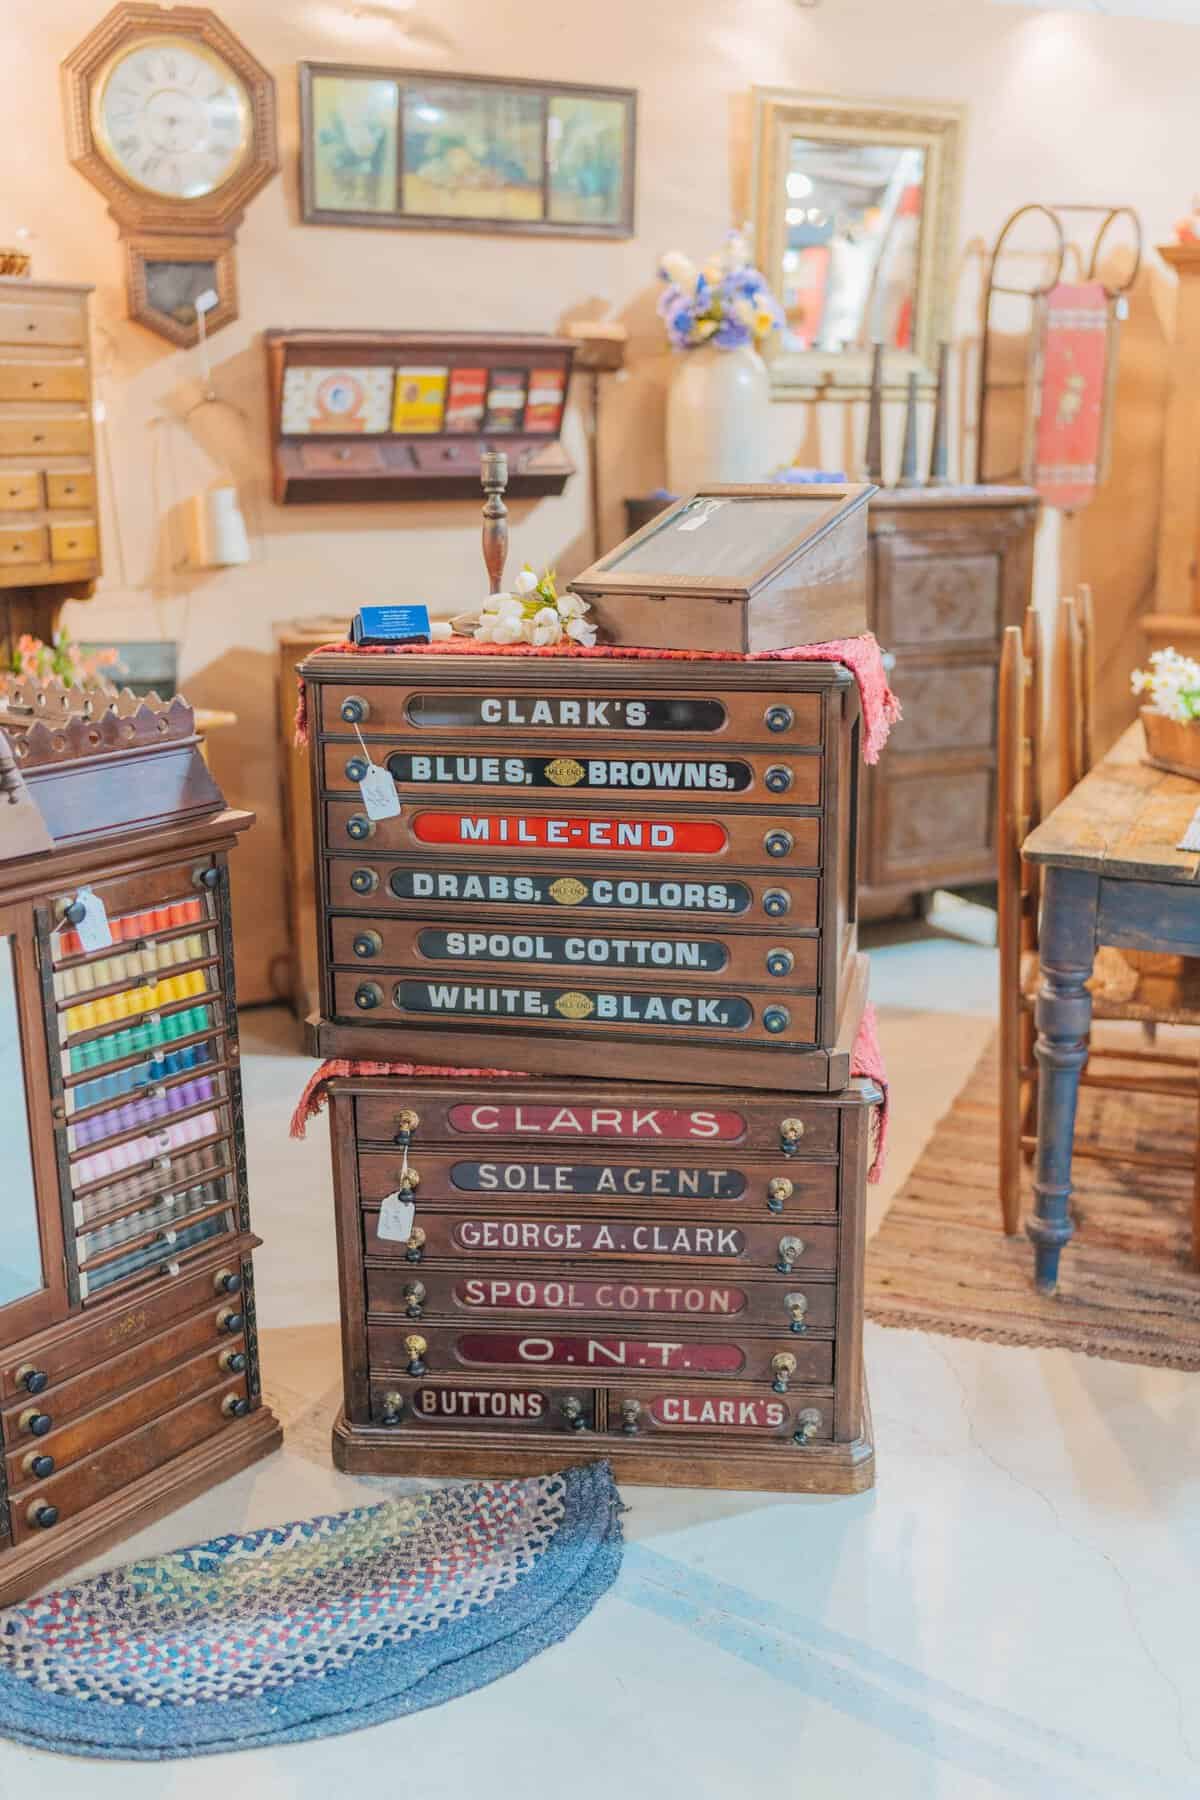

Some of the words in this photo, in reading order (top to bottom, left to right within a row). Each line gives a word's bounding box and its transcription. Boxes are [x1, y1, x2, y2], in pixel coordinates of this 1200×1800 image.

[480, 699, 648, 727] CLARK'S
[411, 756, 532, 784] BLUES,
[588, 760, 735, 789] BROWNS,
[460, 816, 674, 847] MILE-END
[412, 873, 541, 901] DRABS,
[592, 880, 735, 909] COLORS,
[446, 932, 552, 959] SPOOL
[564, 938, 707, 967] COTTON.
[427, 985, 549, 1016] WHITE,
[596, 994, 729, 1024] BLACK,
[471, 1105, 720, 1137] CLARK'S
[478, 1163, 573, 1191] SOLE
[460, 1222, 583, 1248] GEORGE
[466, 1280, 584, 1307] SPOOL
[423, 1390, 543, 1417] BUTTONS
[663, 1398, 785, 1425] CLARK'S
